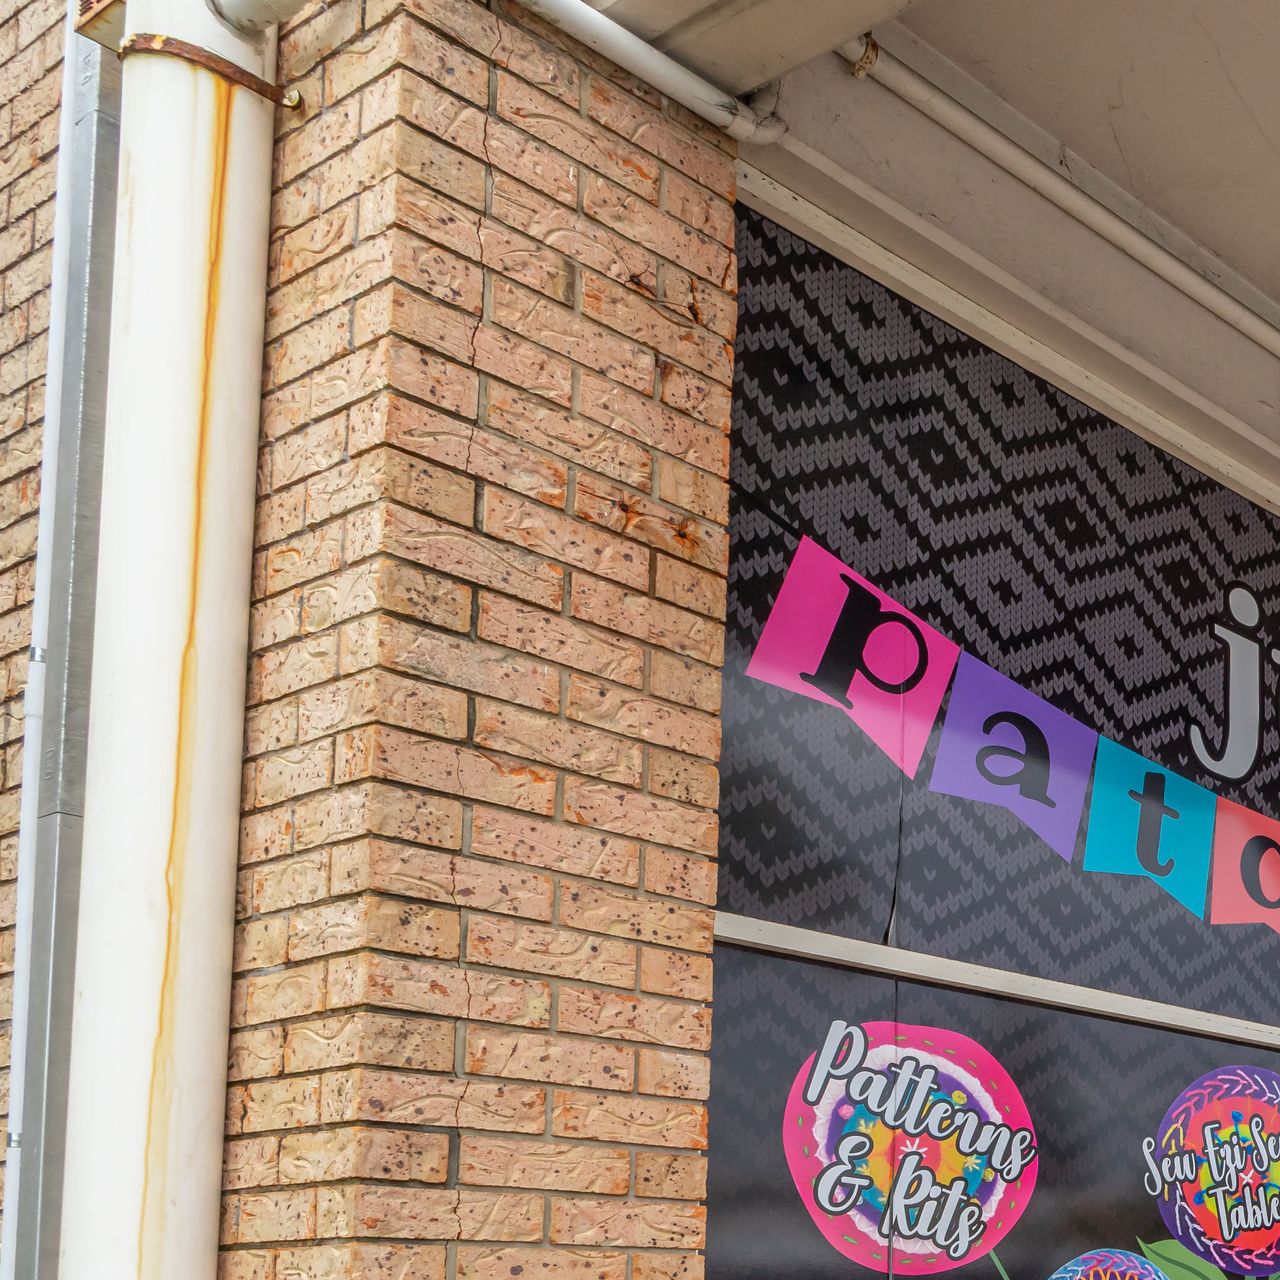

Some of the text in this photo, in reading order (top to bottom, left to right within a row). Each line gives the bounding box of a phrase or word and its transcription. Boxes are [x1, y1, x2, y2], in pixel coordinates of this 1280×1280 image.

[806, 1019, 1036, 1184] Patterns
[1142, 1133, 1197, 1196] Sew
[816, 1133, 987, 1260] & Kits
